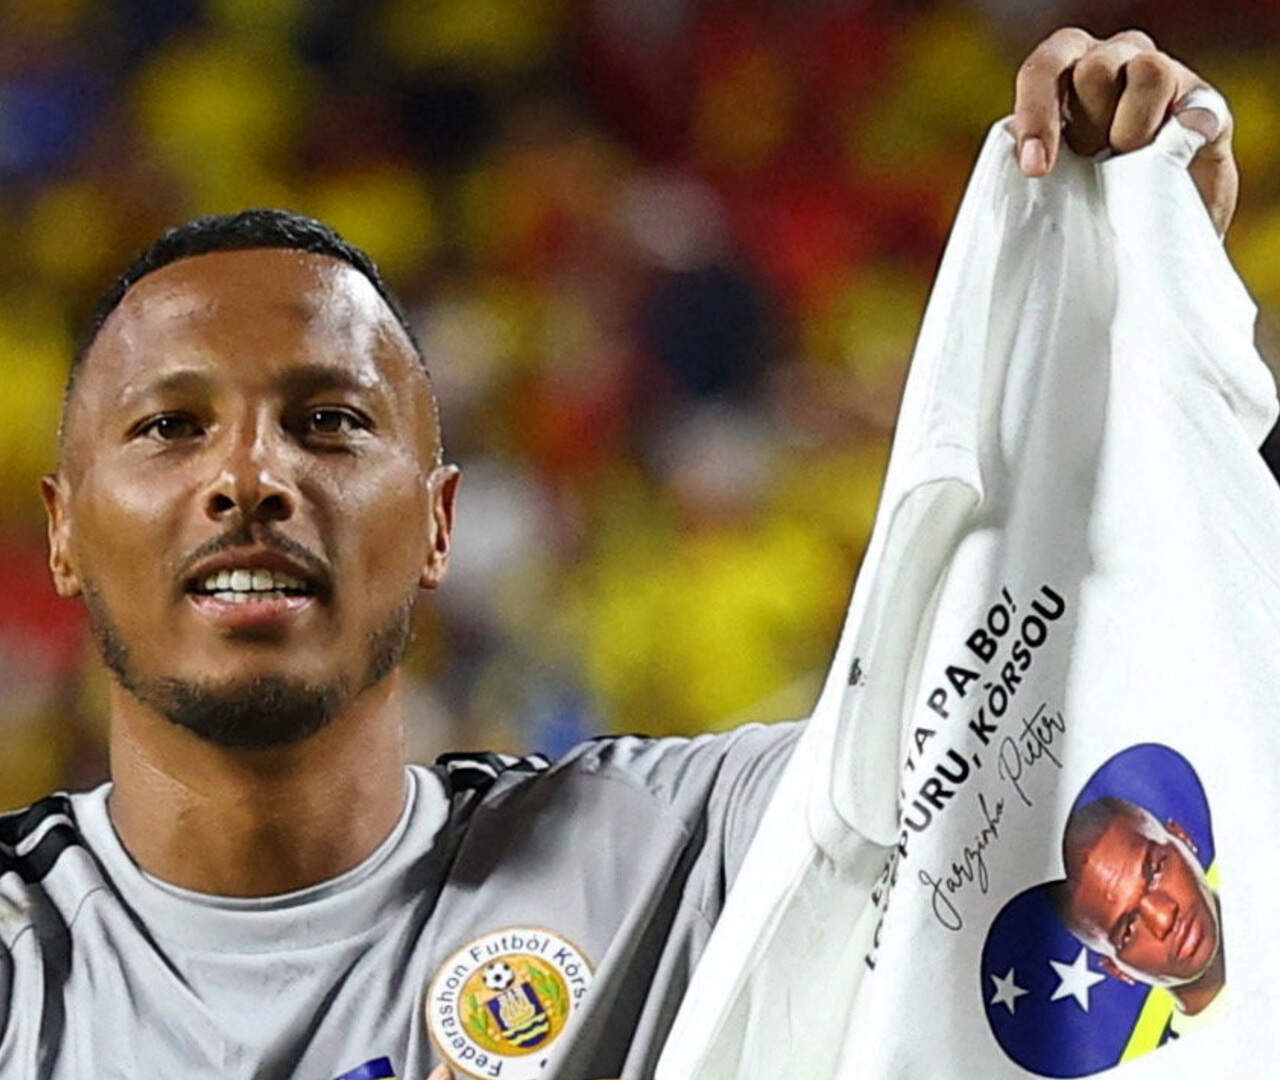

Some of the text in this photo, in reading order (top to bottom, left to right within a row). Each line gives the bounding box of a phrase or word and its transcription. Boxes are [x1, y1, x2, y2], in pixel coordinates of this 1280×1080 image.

[926, 664, 981, 720] PA
[965, 586, 1017, 664] BO!
[969, 584, 1066, 746] KÒRSOU
[436, 964, 503, 1078] Federashon
